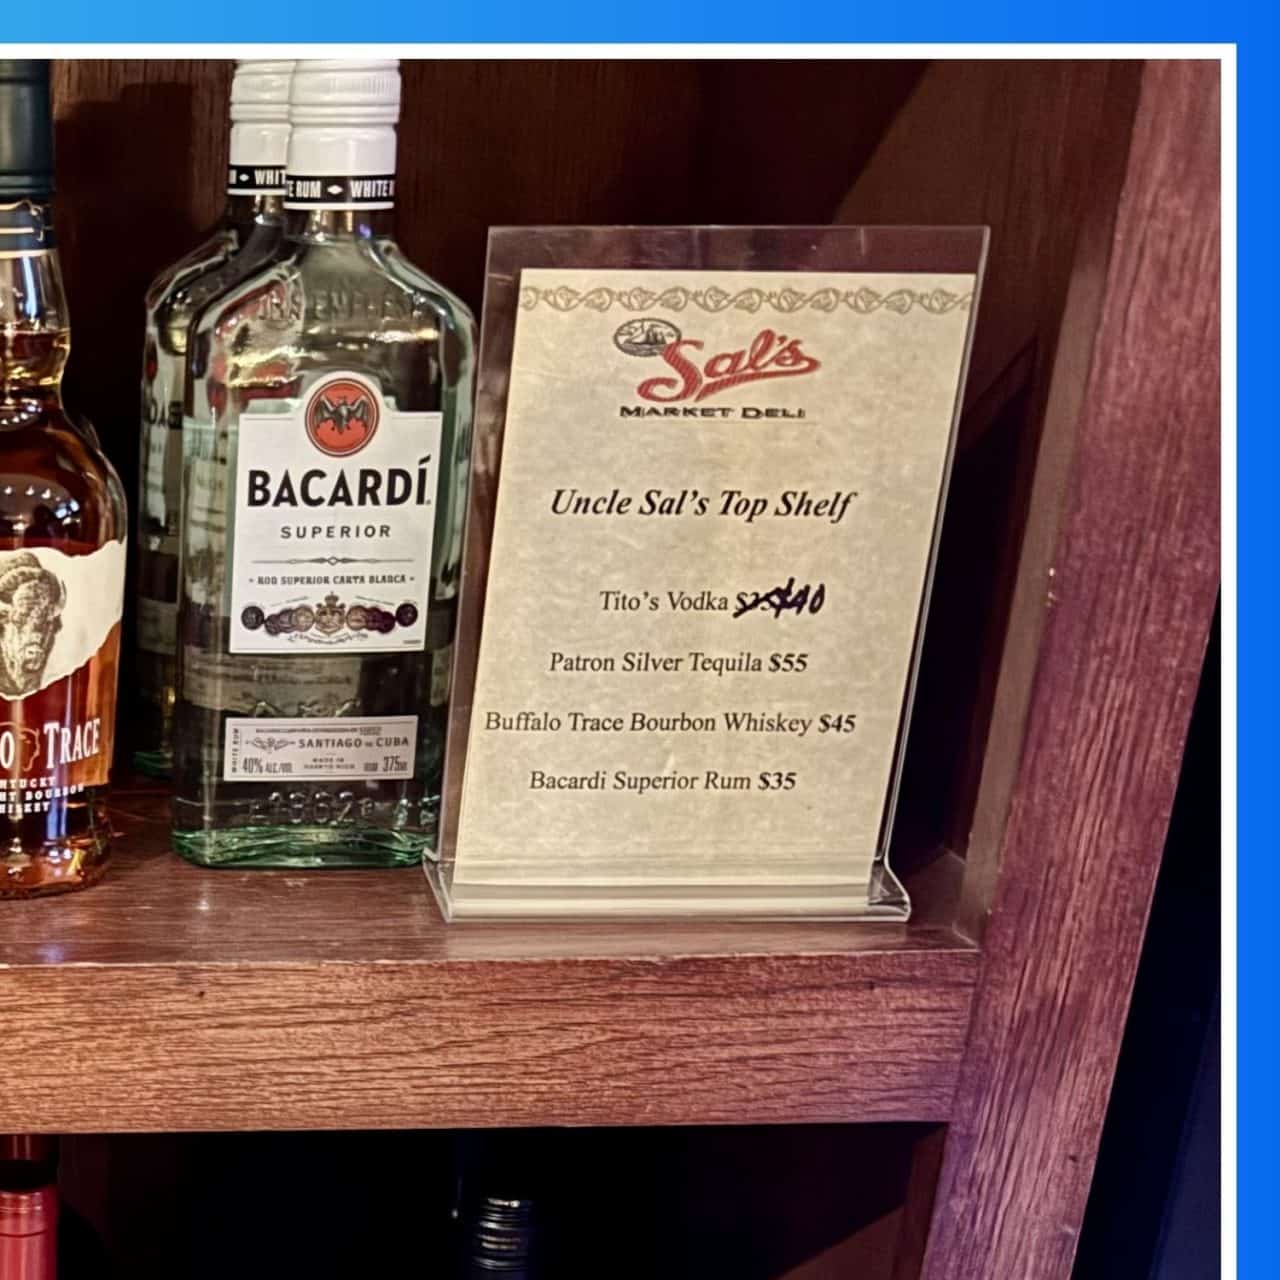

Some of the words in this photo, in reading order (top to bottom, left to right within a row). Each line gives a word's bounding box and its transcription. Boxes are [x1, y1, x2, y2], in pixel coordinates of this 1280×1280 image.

[296, 181, 321, 198] RUM
[350, 181, 388, 198] WHITE
[636, 328, 822, 402] Sal’s
[619, 406, 735, 418] MARKET
[741, 407, 806, 420] DELI
[247, 454, 432, 508] BACARDÍ
[550, 488, 633, 516] Uncle
[637, 489, 710, 517] Sal’s
[719, 491, 769, 523] Top
[773, 490, 858, 524] Shelf
[280, 525, 392, 539] SUPERIOR
[280, 576, 331, 585] SUPERIOR
[600, 590, 660, 612] Tito’s
[666, 590, 729, 612] Vodka
[549, 652, 616, 673] Patron
[621, 652, 685, 673] Silver
[688, 652, 763, 677] Tequila
[767, 652, 809, 674] $55
[485, 711, 562, 733] Buffalo
[567, 711, 624, 733] Trace
[629, 711, 717, 733] Bourbon
[724, 711, 813, 737] Whiskey
[817, 712, 857, 734] $45
[43, 718, 102, 770] TRACE
[298, 738, 362, 749] SANTIAGO
[375, 736, 409, 748] CUBA
[24, 782, 85, 801] BOURBON
[529, 770, 607, 792] Bacardi
[612, 770, 699, 797] Superior
[703, 770, 752, 792] Rum
[756, 770, 797, 792] $35
